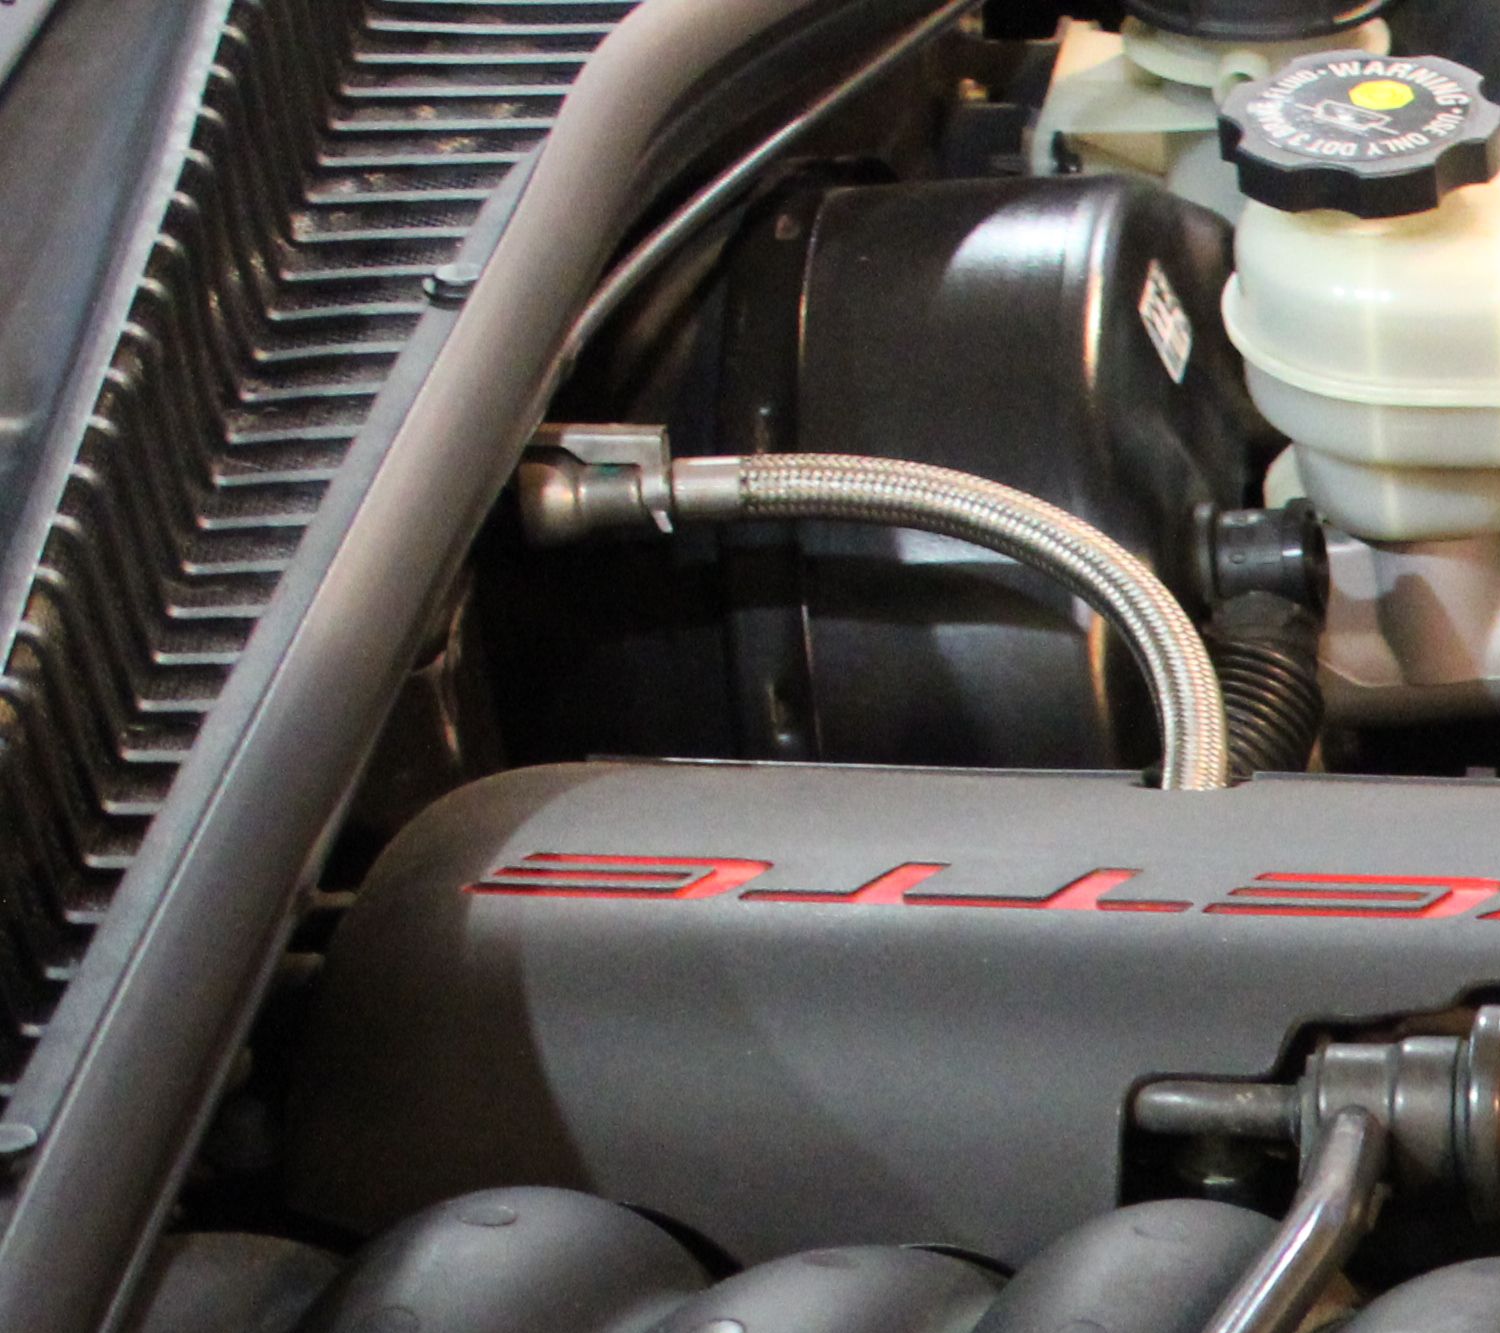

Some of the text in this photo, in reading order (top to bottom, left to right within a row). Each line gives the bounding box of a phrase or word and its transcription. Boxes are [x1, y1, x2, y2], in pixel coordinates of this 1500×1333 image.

[1328, 61, 1472, 106] WARNING
[1421, 112, 1466, 138] USE
[1304, 140, 1358, 157] DOT
[1366, 131, 1430, 156] ONLY
